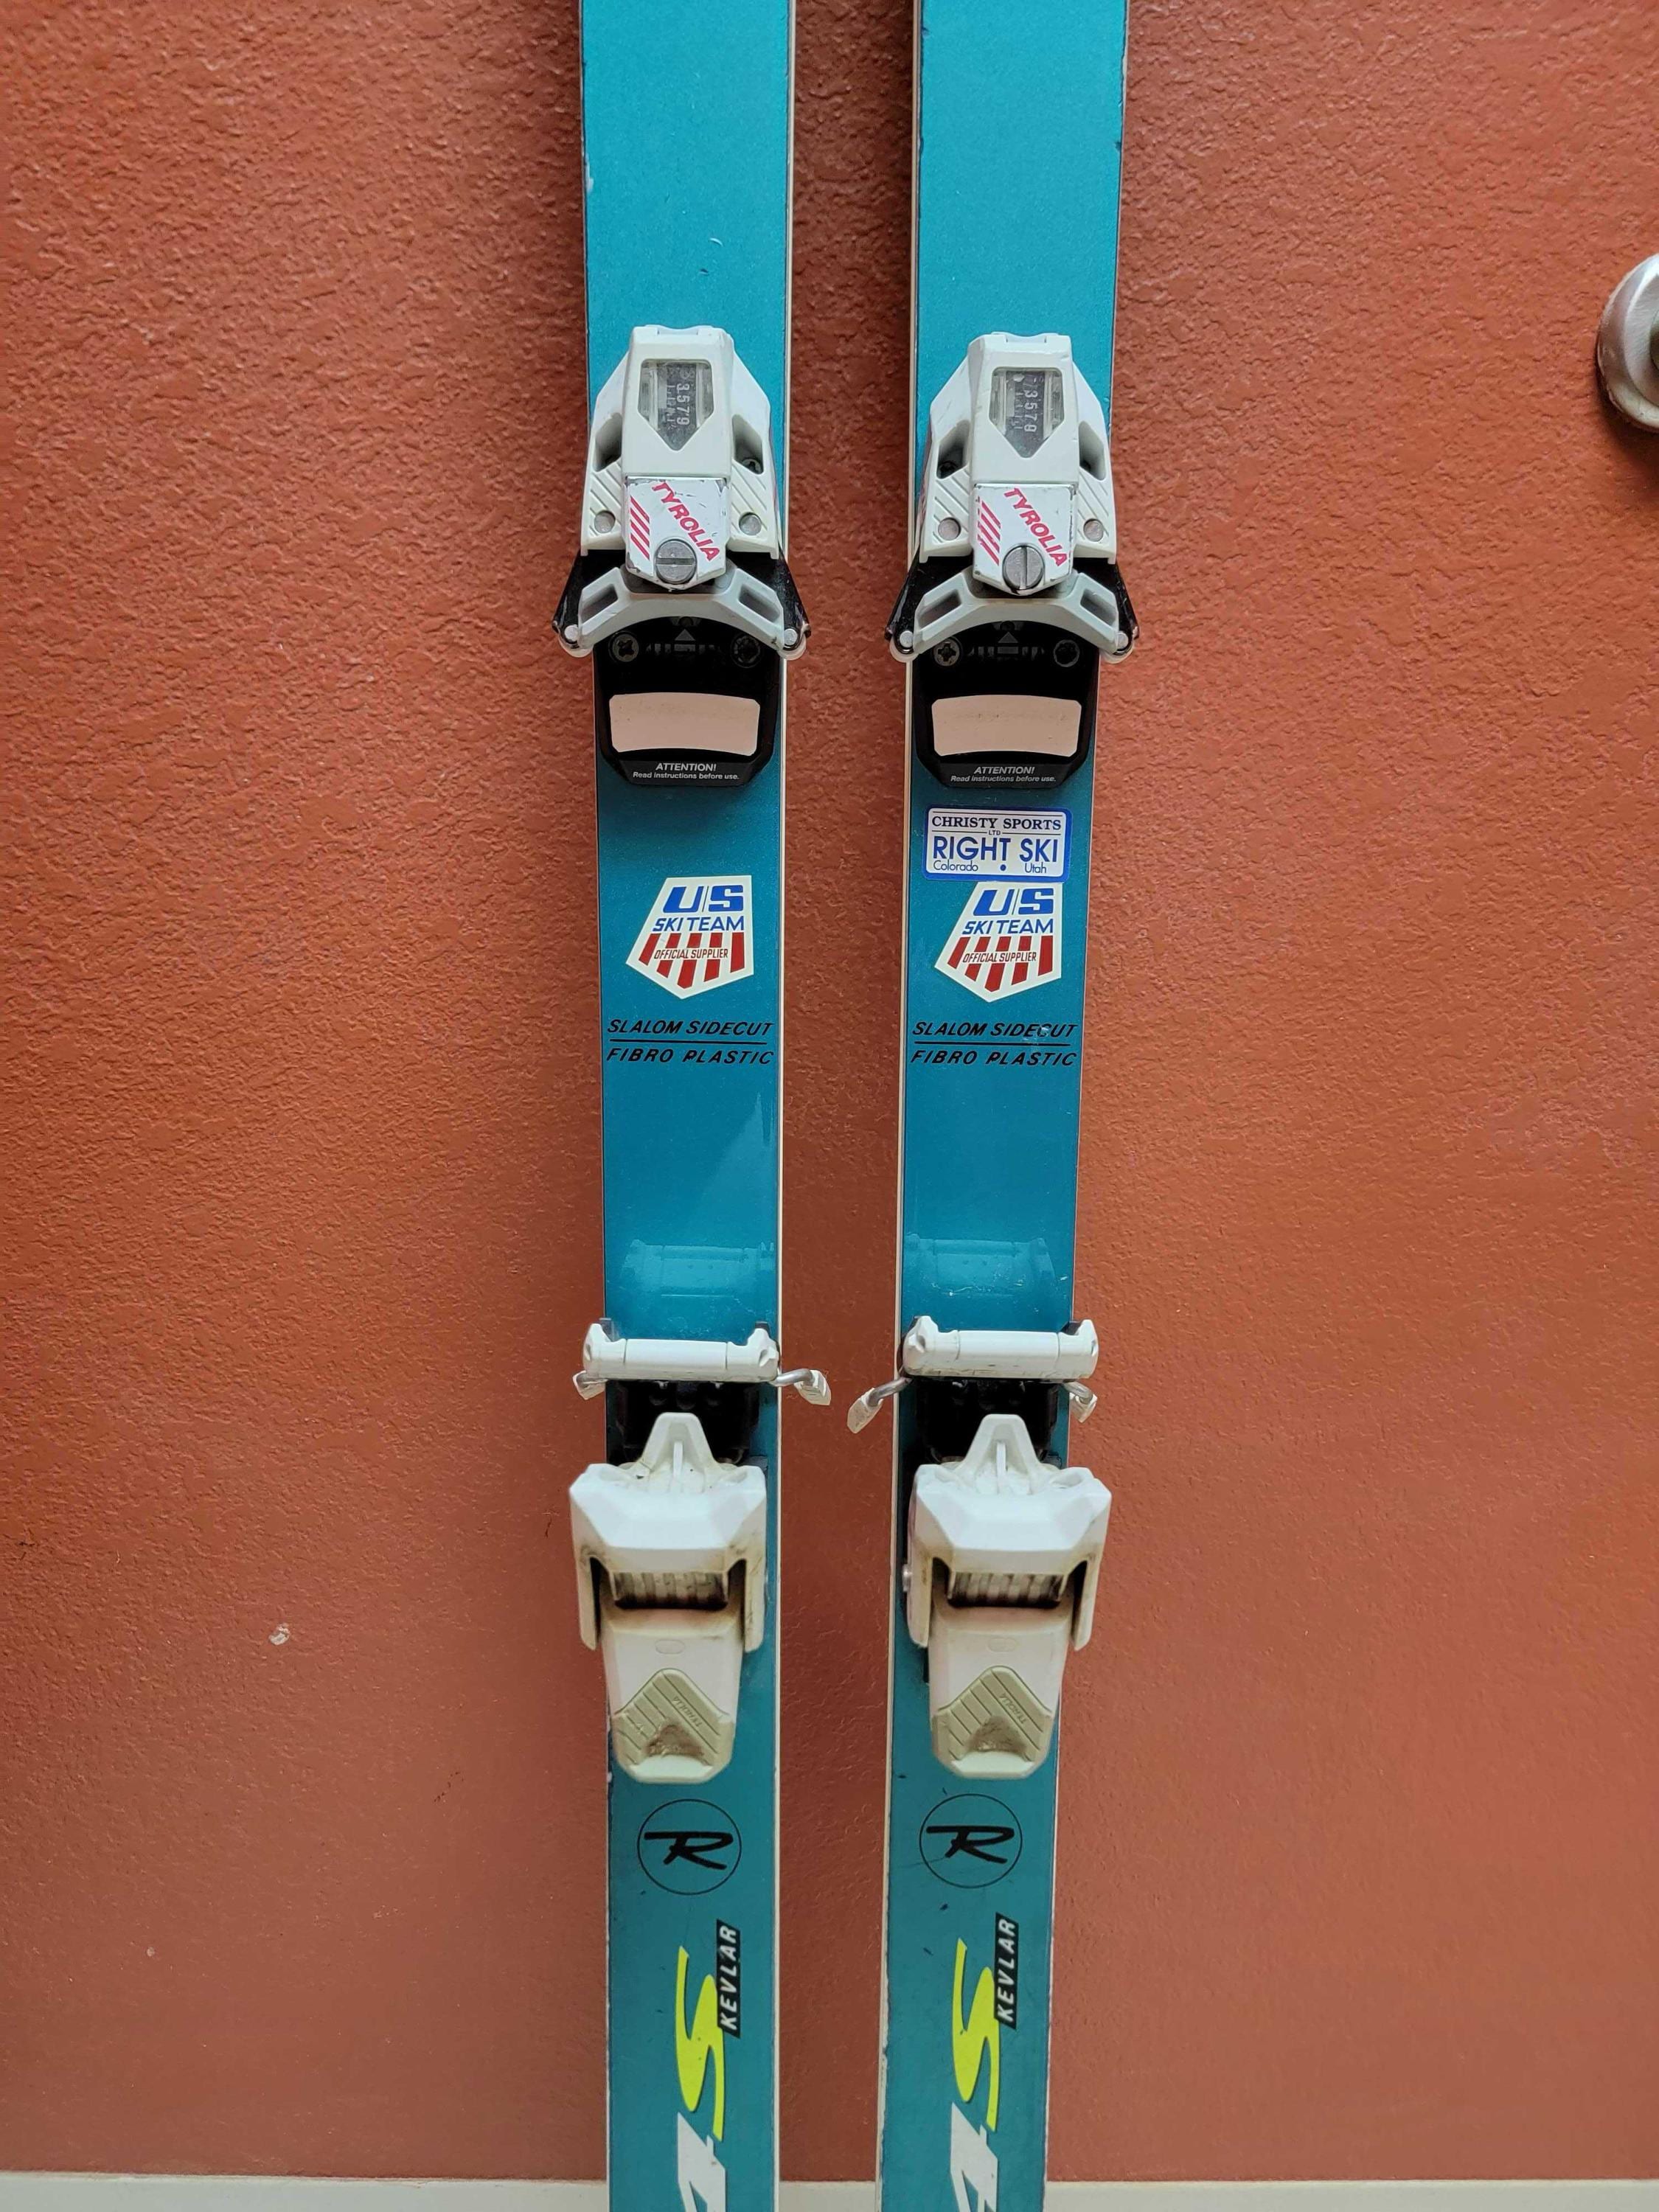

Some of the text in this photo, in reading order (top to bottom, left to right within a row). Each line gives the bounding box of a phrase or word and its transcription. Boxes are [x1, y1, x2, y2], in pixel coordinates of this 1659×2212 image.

[652, 481, 720, 561] TYROLIA
[1004, 487, 1068, 566] TYROLIA
[655, 762, 717, 771] ATTENTION!
[973, 766, 1035, 774] ATTENTION!
[931, 815, 1061, 830] CHRISTY SPORTS
[933, 835, 1058, 863] RIGHT SKI
[933, 858, 1047, 874] Colorado Utah
[663, 884, 744, 914] US
[973, 888, 1054, 917] US
[652, 915, 745, 932] SKI TEAM
[961, 918, 1054, 935] SKI TEAM
[653, 948, 728, 959] OFFICIAL SUPPLIER
[962, 951, 1037, 963] OFFICIAL SUPPLIER
[607, 1019, 773, 1036] SLALOM SIDECUT
[912, 1021, 1077, 1037] SLALOM SIDECUT
[606, 1048, 774, 1065] FIBRO PLASTIC
[910, 1050, 1077, 1066] FIBRO PLASTIC
[719, 1924, 738, 2031] KEVLAR
[996, 1917, 1015, 2023] KEVLAR
